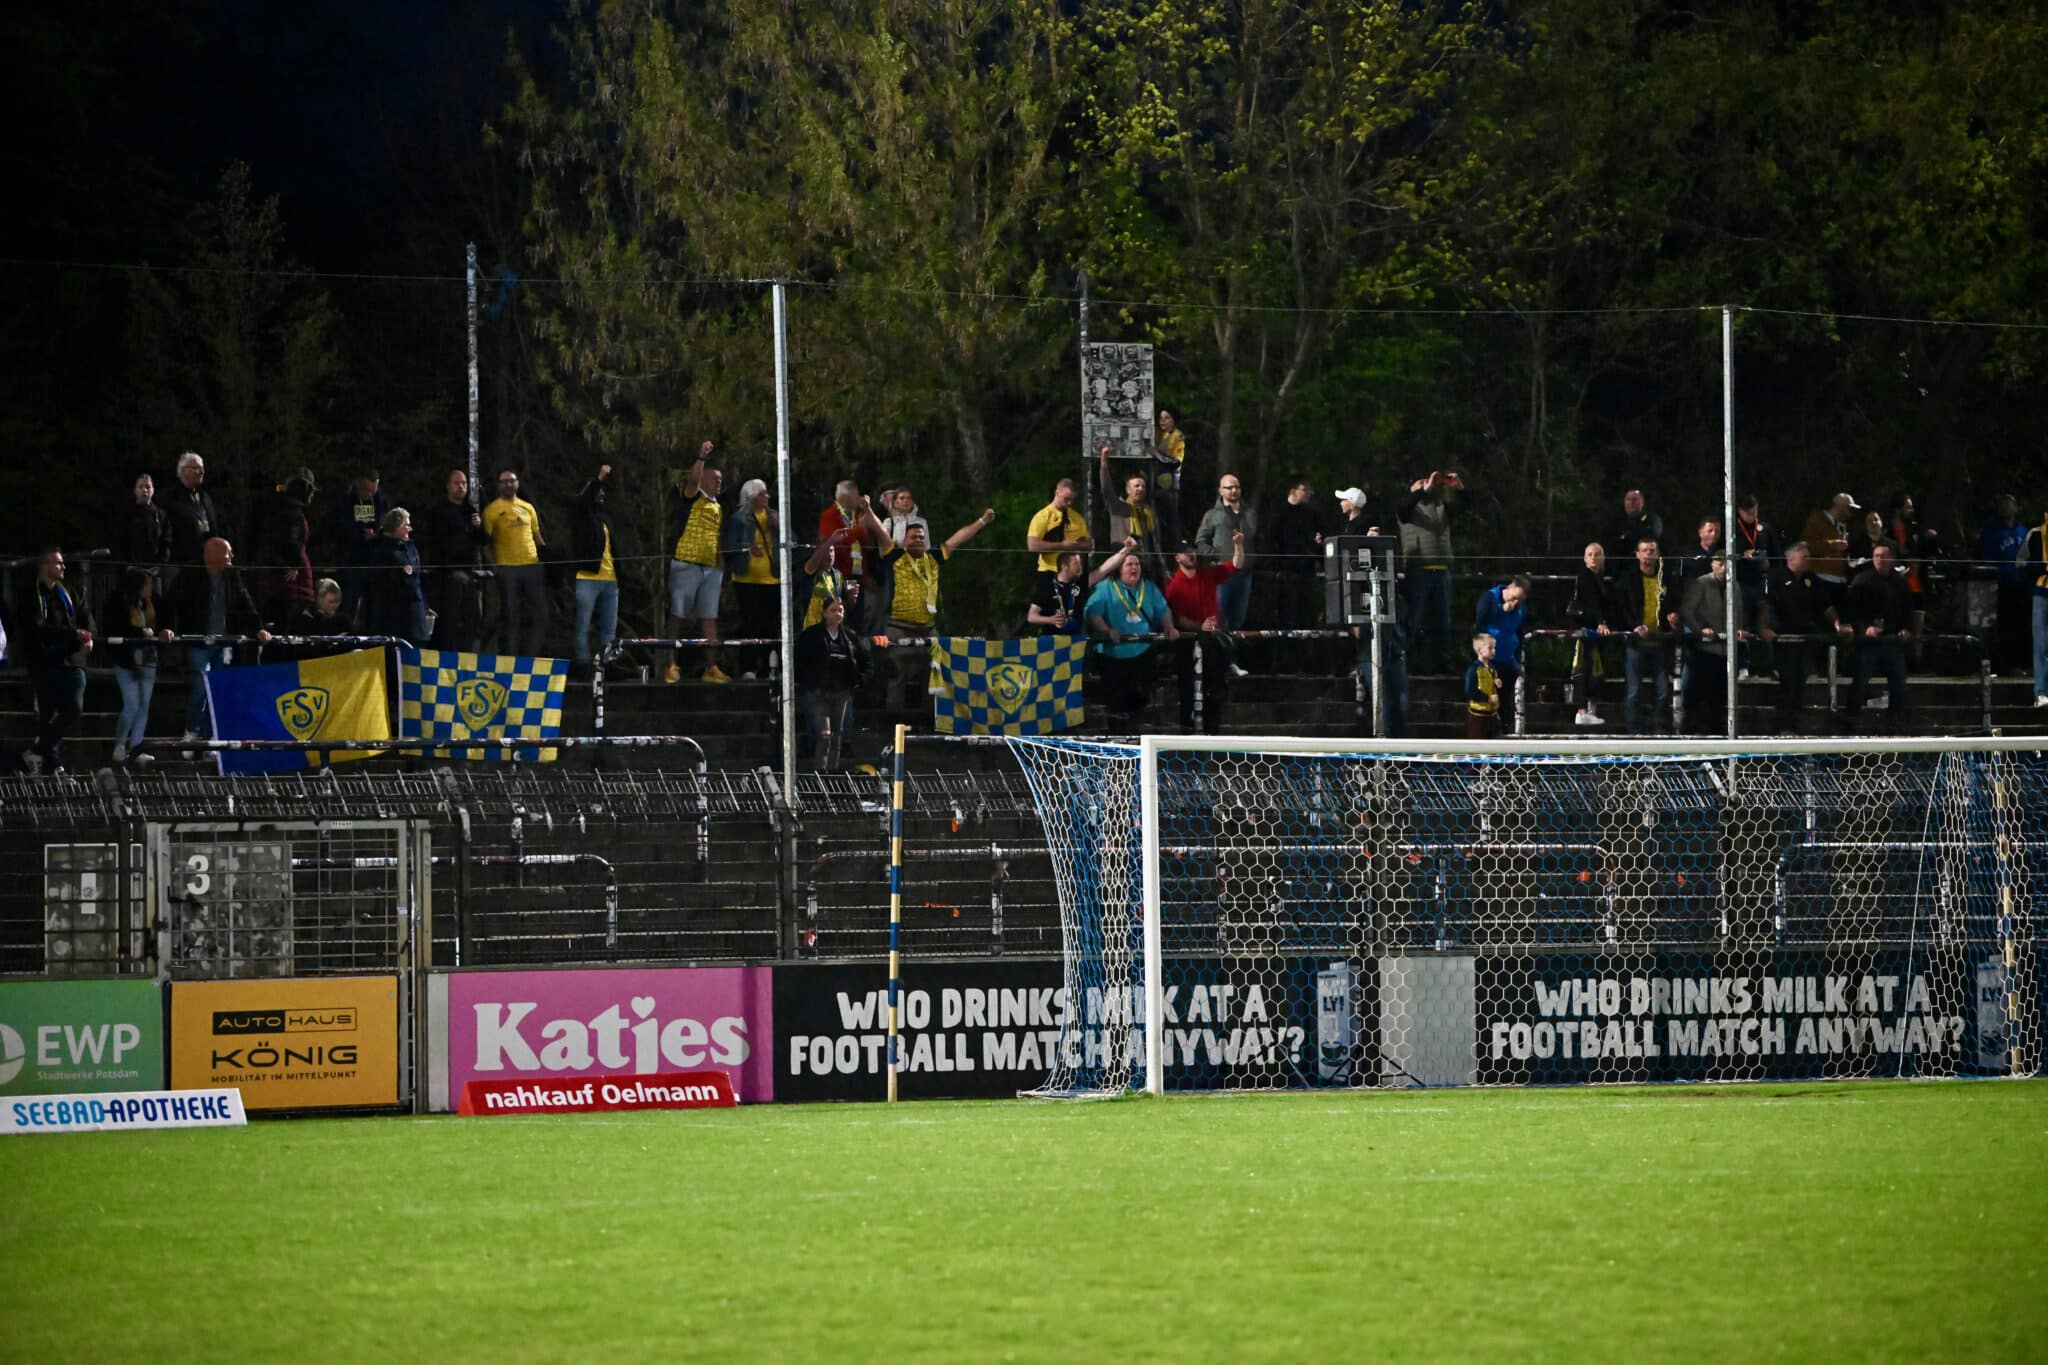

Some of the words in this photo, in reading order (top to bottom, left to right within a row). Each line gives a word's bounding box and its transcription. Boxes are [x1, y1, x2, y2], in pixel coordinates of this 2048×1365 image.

[461, 682, 504, 717] FSV
[990, 665, 1028, 700] FSV
[281, 691, 324, 729] FSV
[186, 854, 211, 895] 3
[836, 988, 931, 1031] WHO
[941, 987, 1073, 1029] DRINKS
[1187, 984, 1235, 1024] AT
[1242, 984, 1269, 1023] A
[1534, 978, 1621, 1017] WHO
[1630, 976, 1753, 1016] DRINKS
[1762, 976, 1848, 1014] MILK
[1856, 975, 1900, 1012] AT
[1907, 975, 1932, 1012] A
[37, 1023, 141, 1066] EWP
[472, 996, 750, 1074] Katjes
[789, 1032, 975, 1076] FOOTBALL
[981, 1029, 1112, 1071] MATCH
[1492, 1020, 1661, 1060] FOOTBALL
[1667, 1017, 1786, 1057] MATCH
[1795, 1015, 1966, 1055] ANYWAY?
[211, 1040, 358, 1070] KÖNIG
[37, 1070, 94, 1081] Stadtwerke
[96, 1069, 139, 1080] Potsdam
[211, 1072, 267, 1084] MOBILITÄT
[271, 1073, 283, 1081] IM
[286, 1070, 358, 1080] MITTELPUNKT
[12, 1095, 232, 1127] SEEBAD-APOTHEKE
[484, 1084, 594, 1109] nahkauf
[601, 1081, 720, 1105] Oelmann
